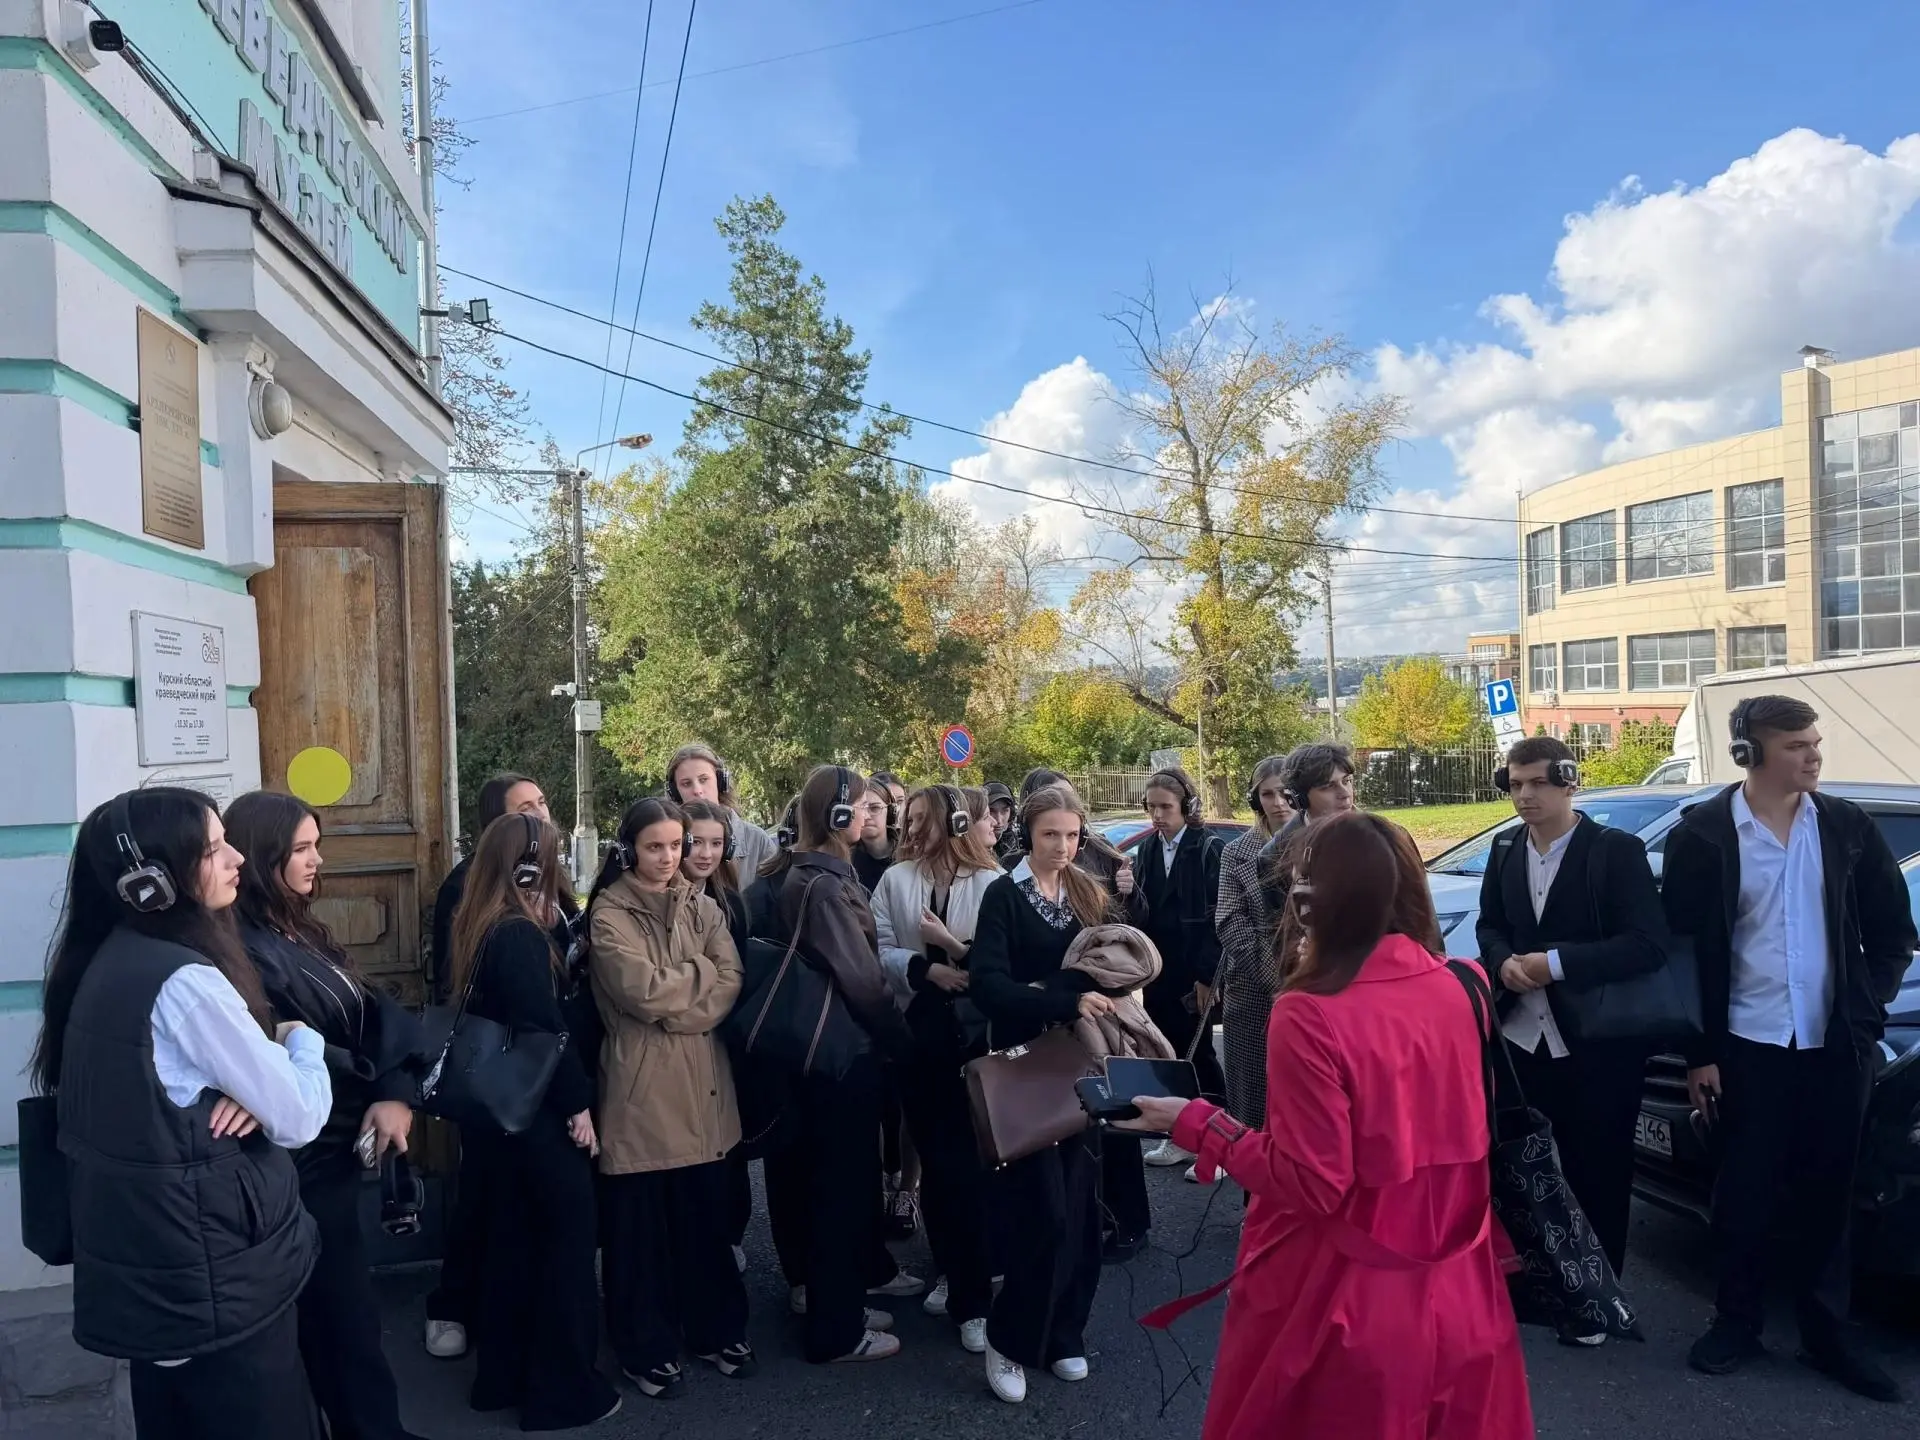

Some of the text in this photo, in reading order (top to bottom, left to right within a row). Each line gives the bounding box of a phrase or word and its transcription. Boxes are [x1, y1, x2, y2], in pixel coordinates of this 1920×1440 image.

[239, 98, 353, 279] МУЗЕЙ
[158, 671, 212, 688] Курский областной
[155, 688, 216, 703] краеведческий музей
[1493, 685, 1508, 711] P
